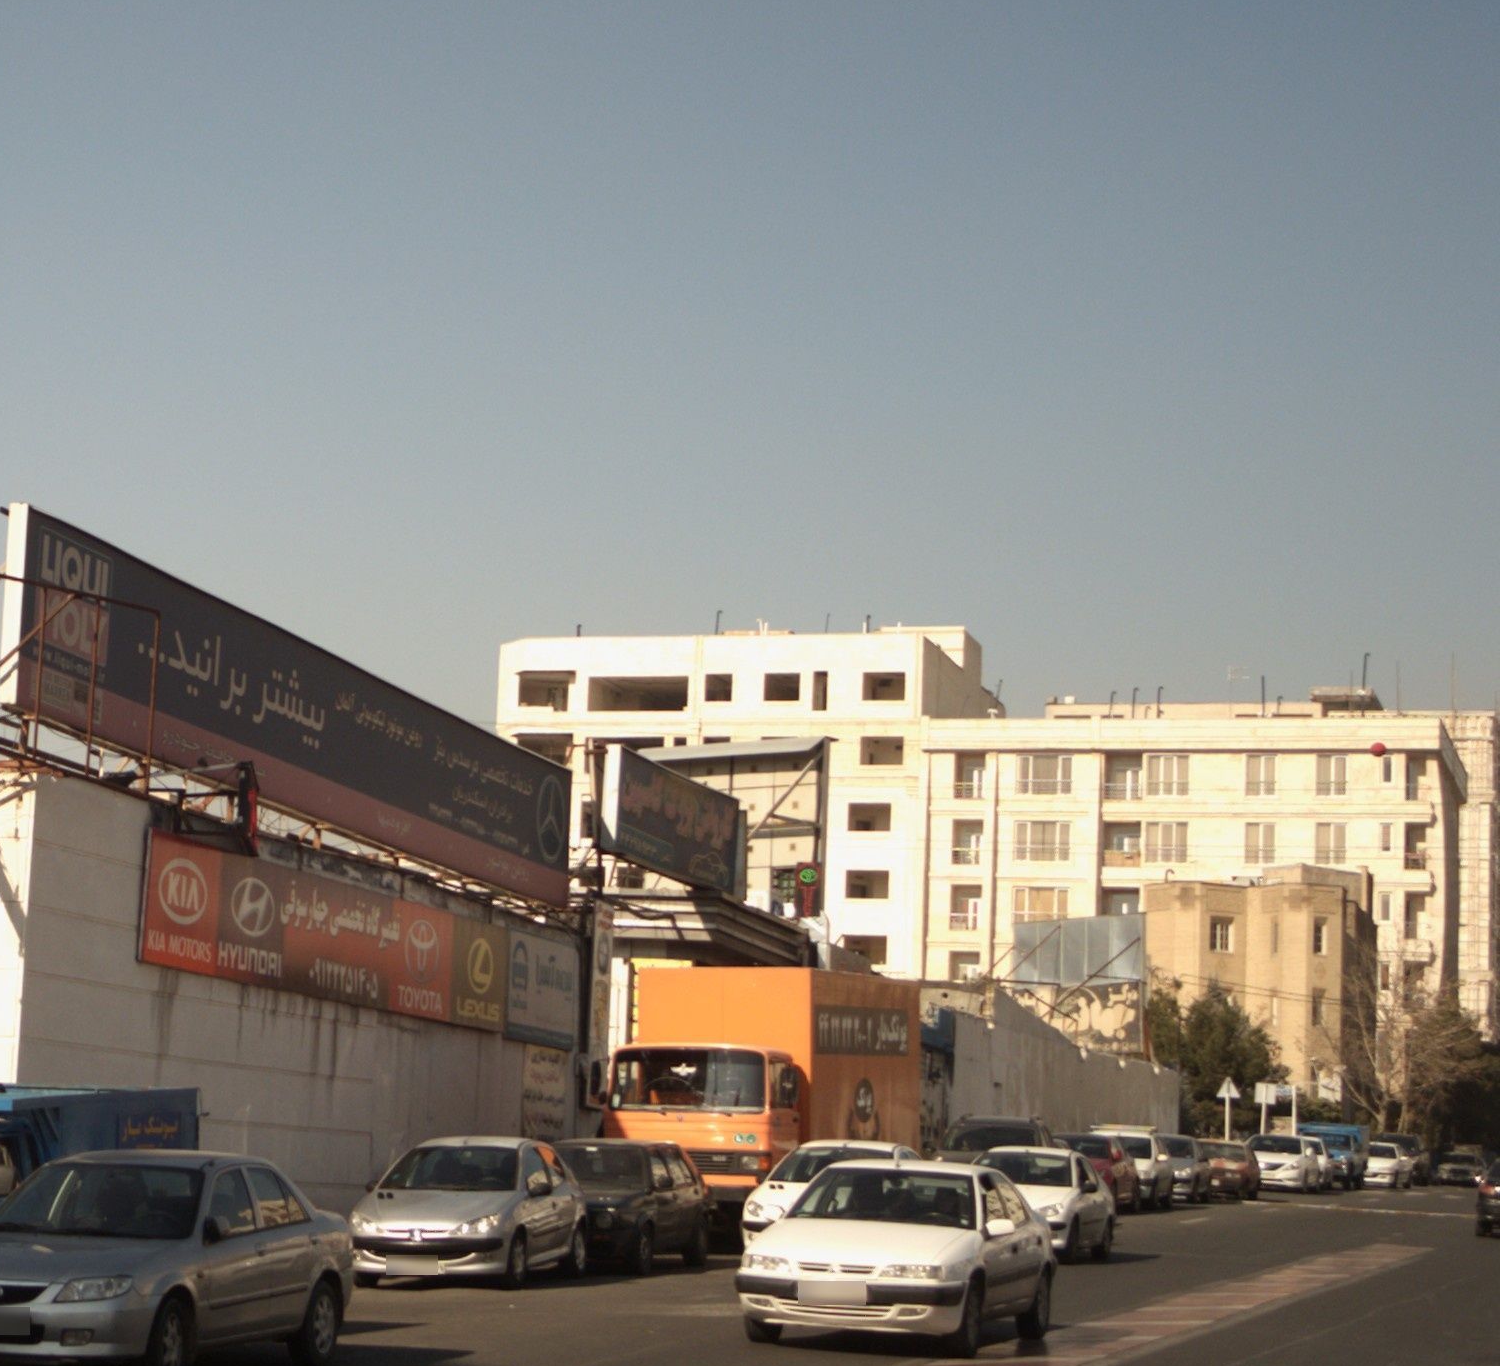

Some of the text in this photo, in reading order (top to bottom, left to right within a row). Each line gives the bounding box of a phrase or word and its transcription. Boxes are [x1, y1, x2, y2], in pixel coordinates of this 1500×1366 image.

[41, 534, 110, 606] LIQUI
[253, 669, 325, 749] بیشتر
[167, 871, 199, 911] KIA
[147, 929, 212, 962] KIA MOTORS
[218, 941, 282, 978] HYUNDAI
[398, 985, 443, 1015] TOYOTA
[457, 996, 499, 1022] LEXUS
